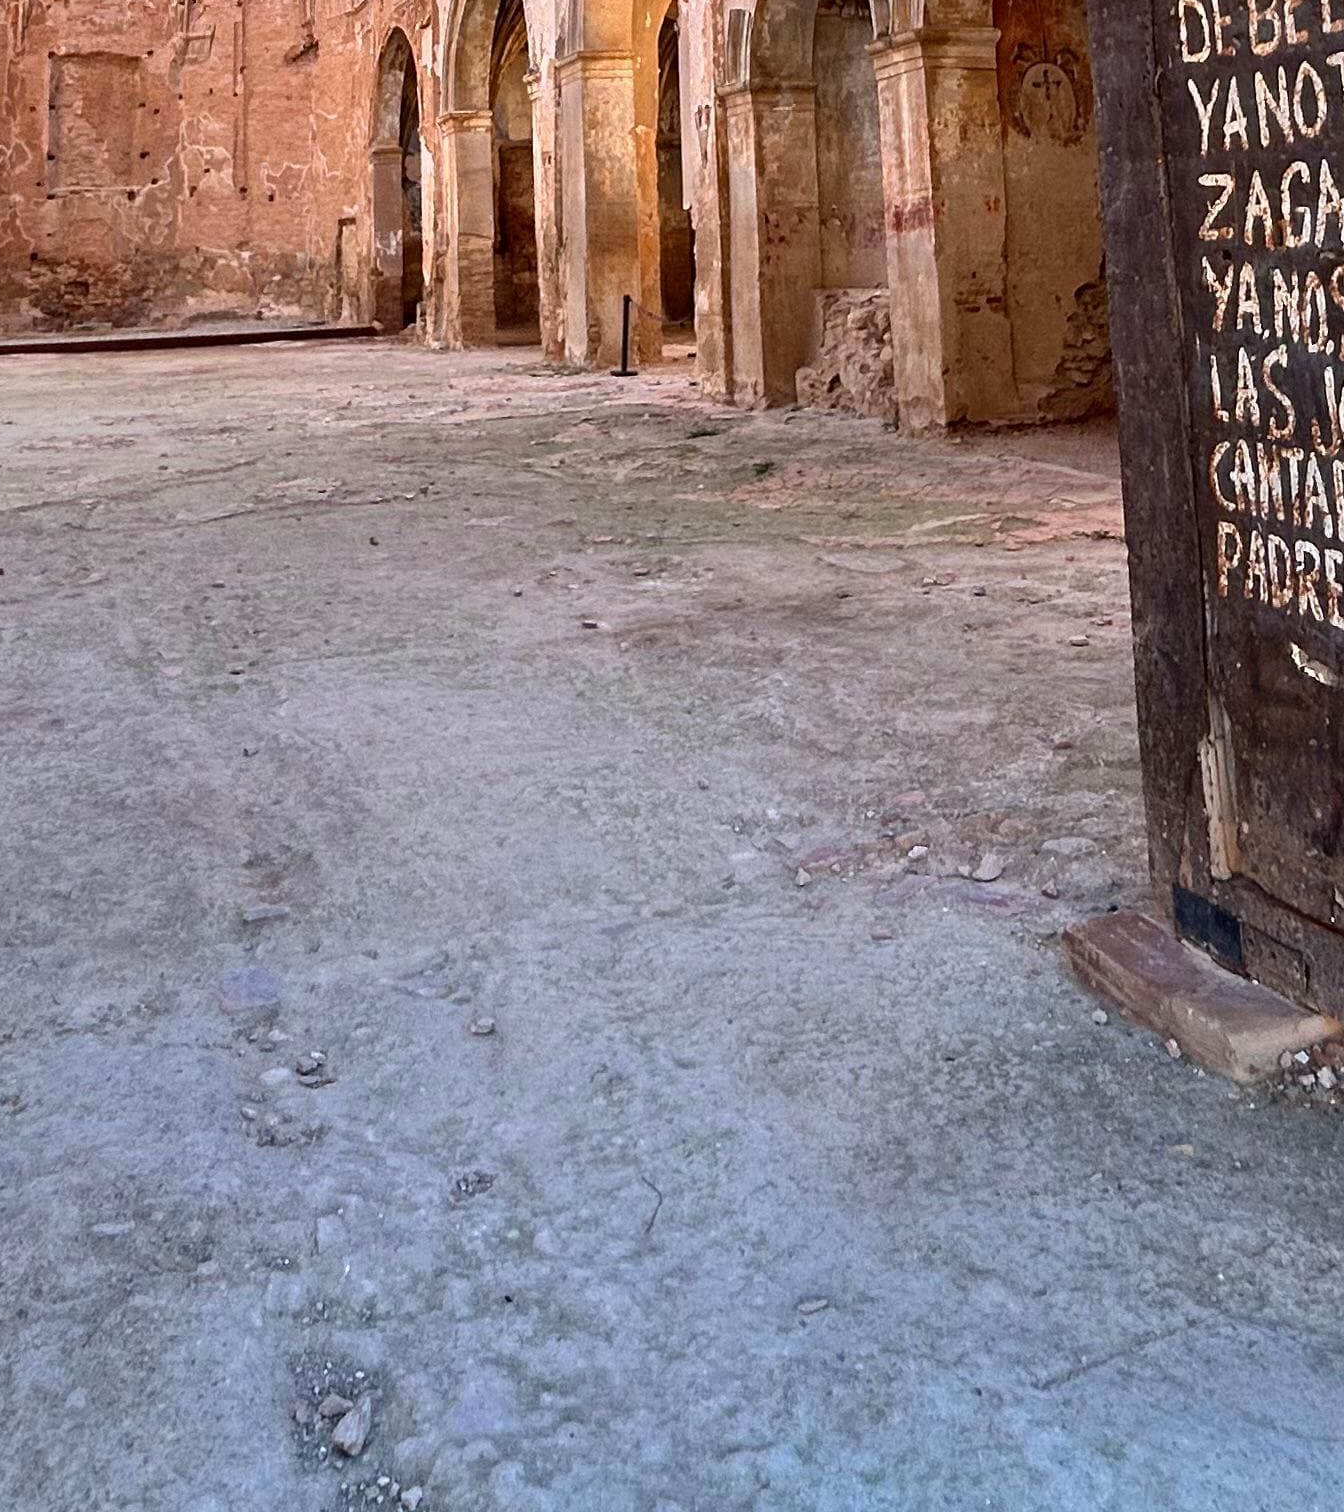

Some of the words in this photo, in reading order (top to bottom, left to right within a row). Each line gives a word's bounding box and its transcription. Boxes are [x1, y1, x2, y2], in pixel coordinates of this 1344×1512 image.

[1188, 75, 1249, 156] YA
[1256, 61, 1328, 148] NO
[1209, 343, 1296, 440] LAS
